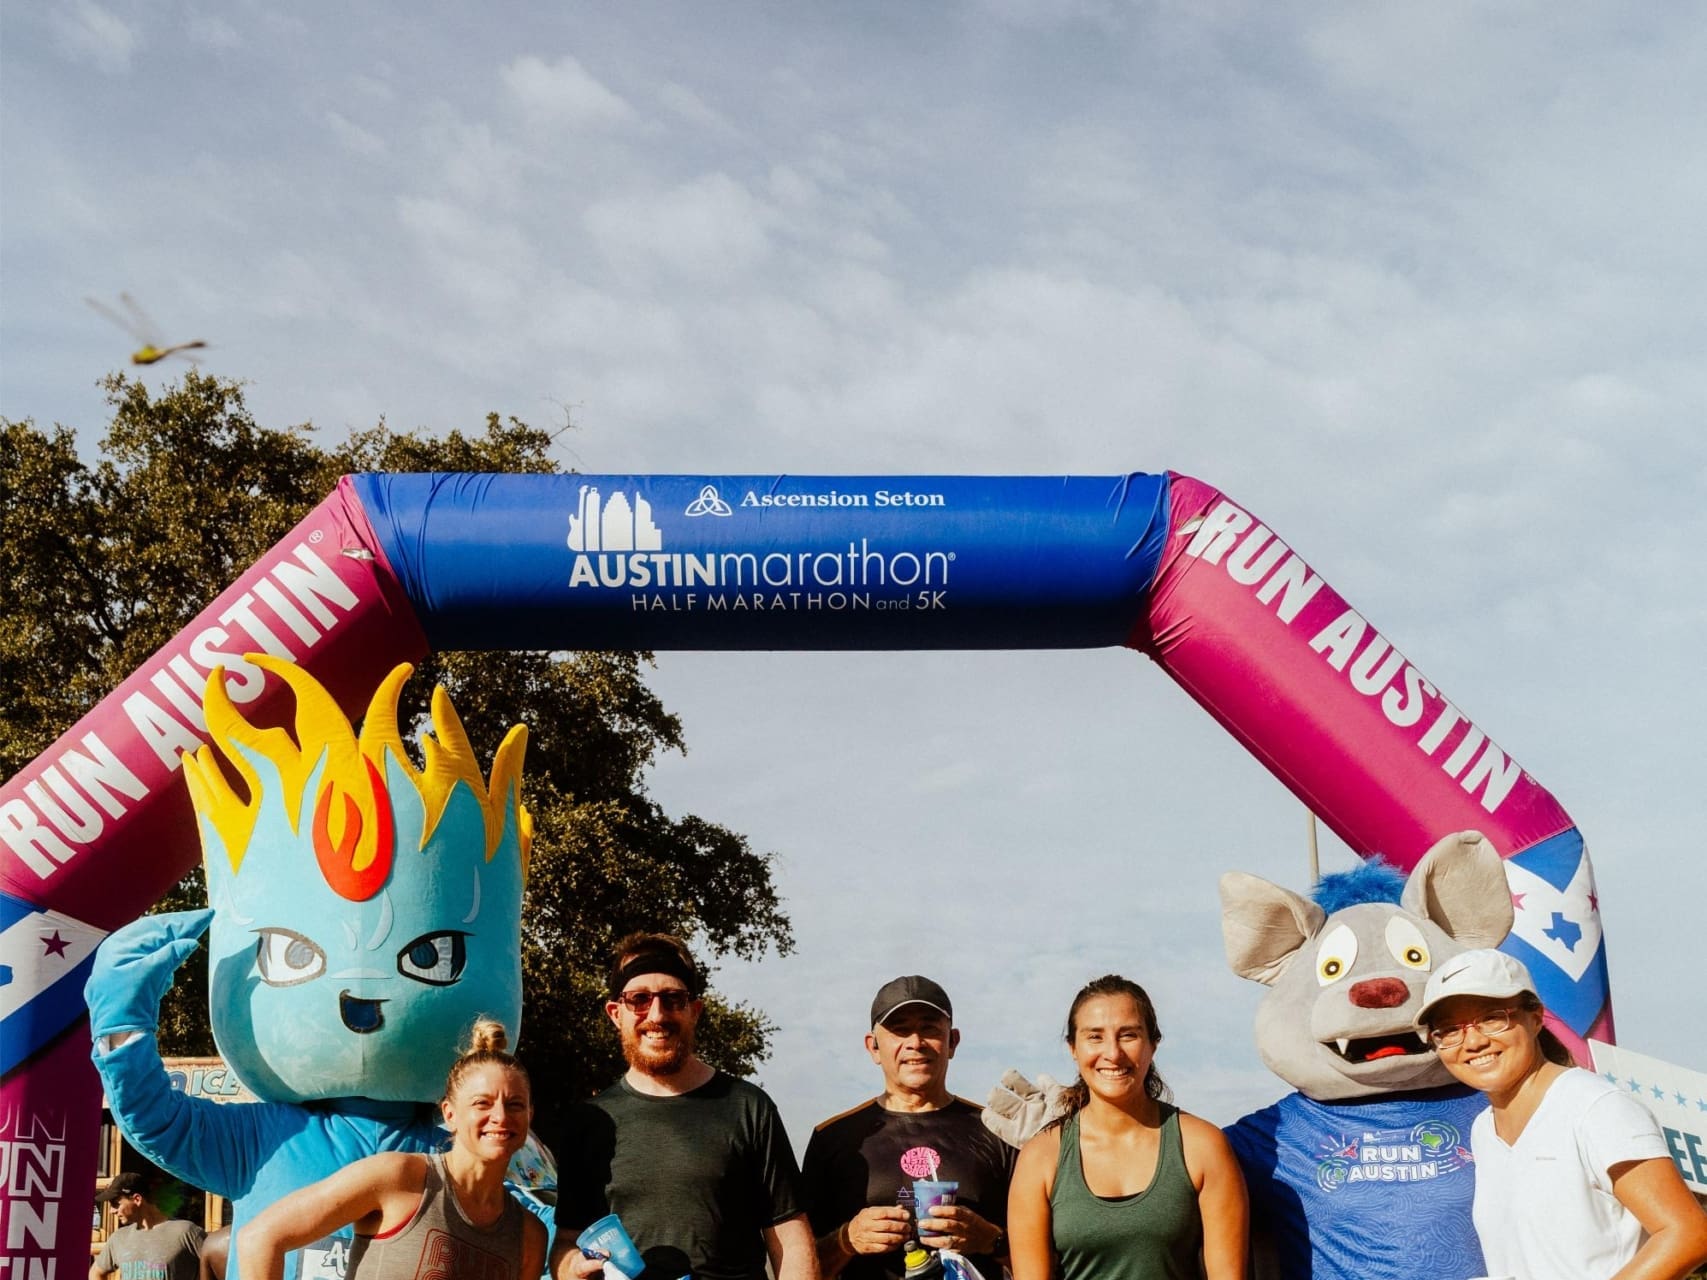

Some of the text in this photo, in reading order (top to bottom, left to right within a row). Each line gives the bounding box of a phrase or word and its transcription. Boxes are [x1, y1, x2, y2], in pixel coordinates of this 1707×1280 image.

[740, 489, 945, 507] Ascension Seton
[632, 590, 947, 611] HALF MARATHON and 5K
[1186, 500, 1522, 814] RUN AUSTIN
[0, 731, 150, 880] RUN
[1361, 1145, 1421, 1162] RUN
[1349, 1162, 1437, 1182] AUSTIN
